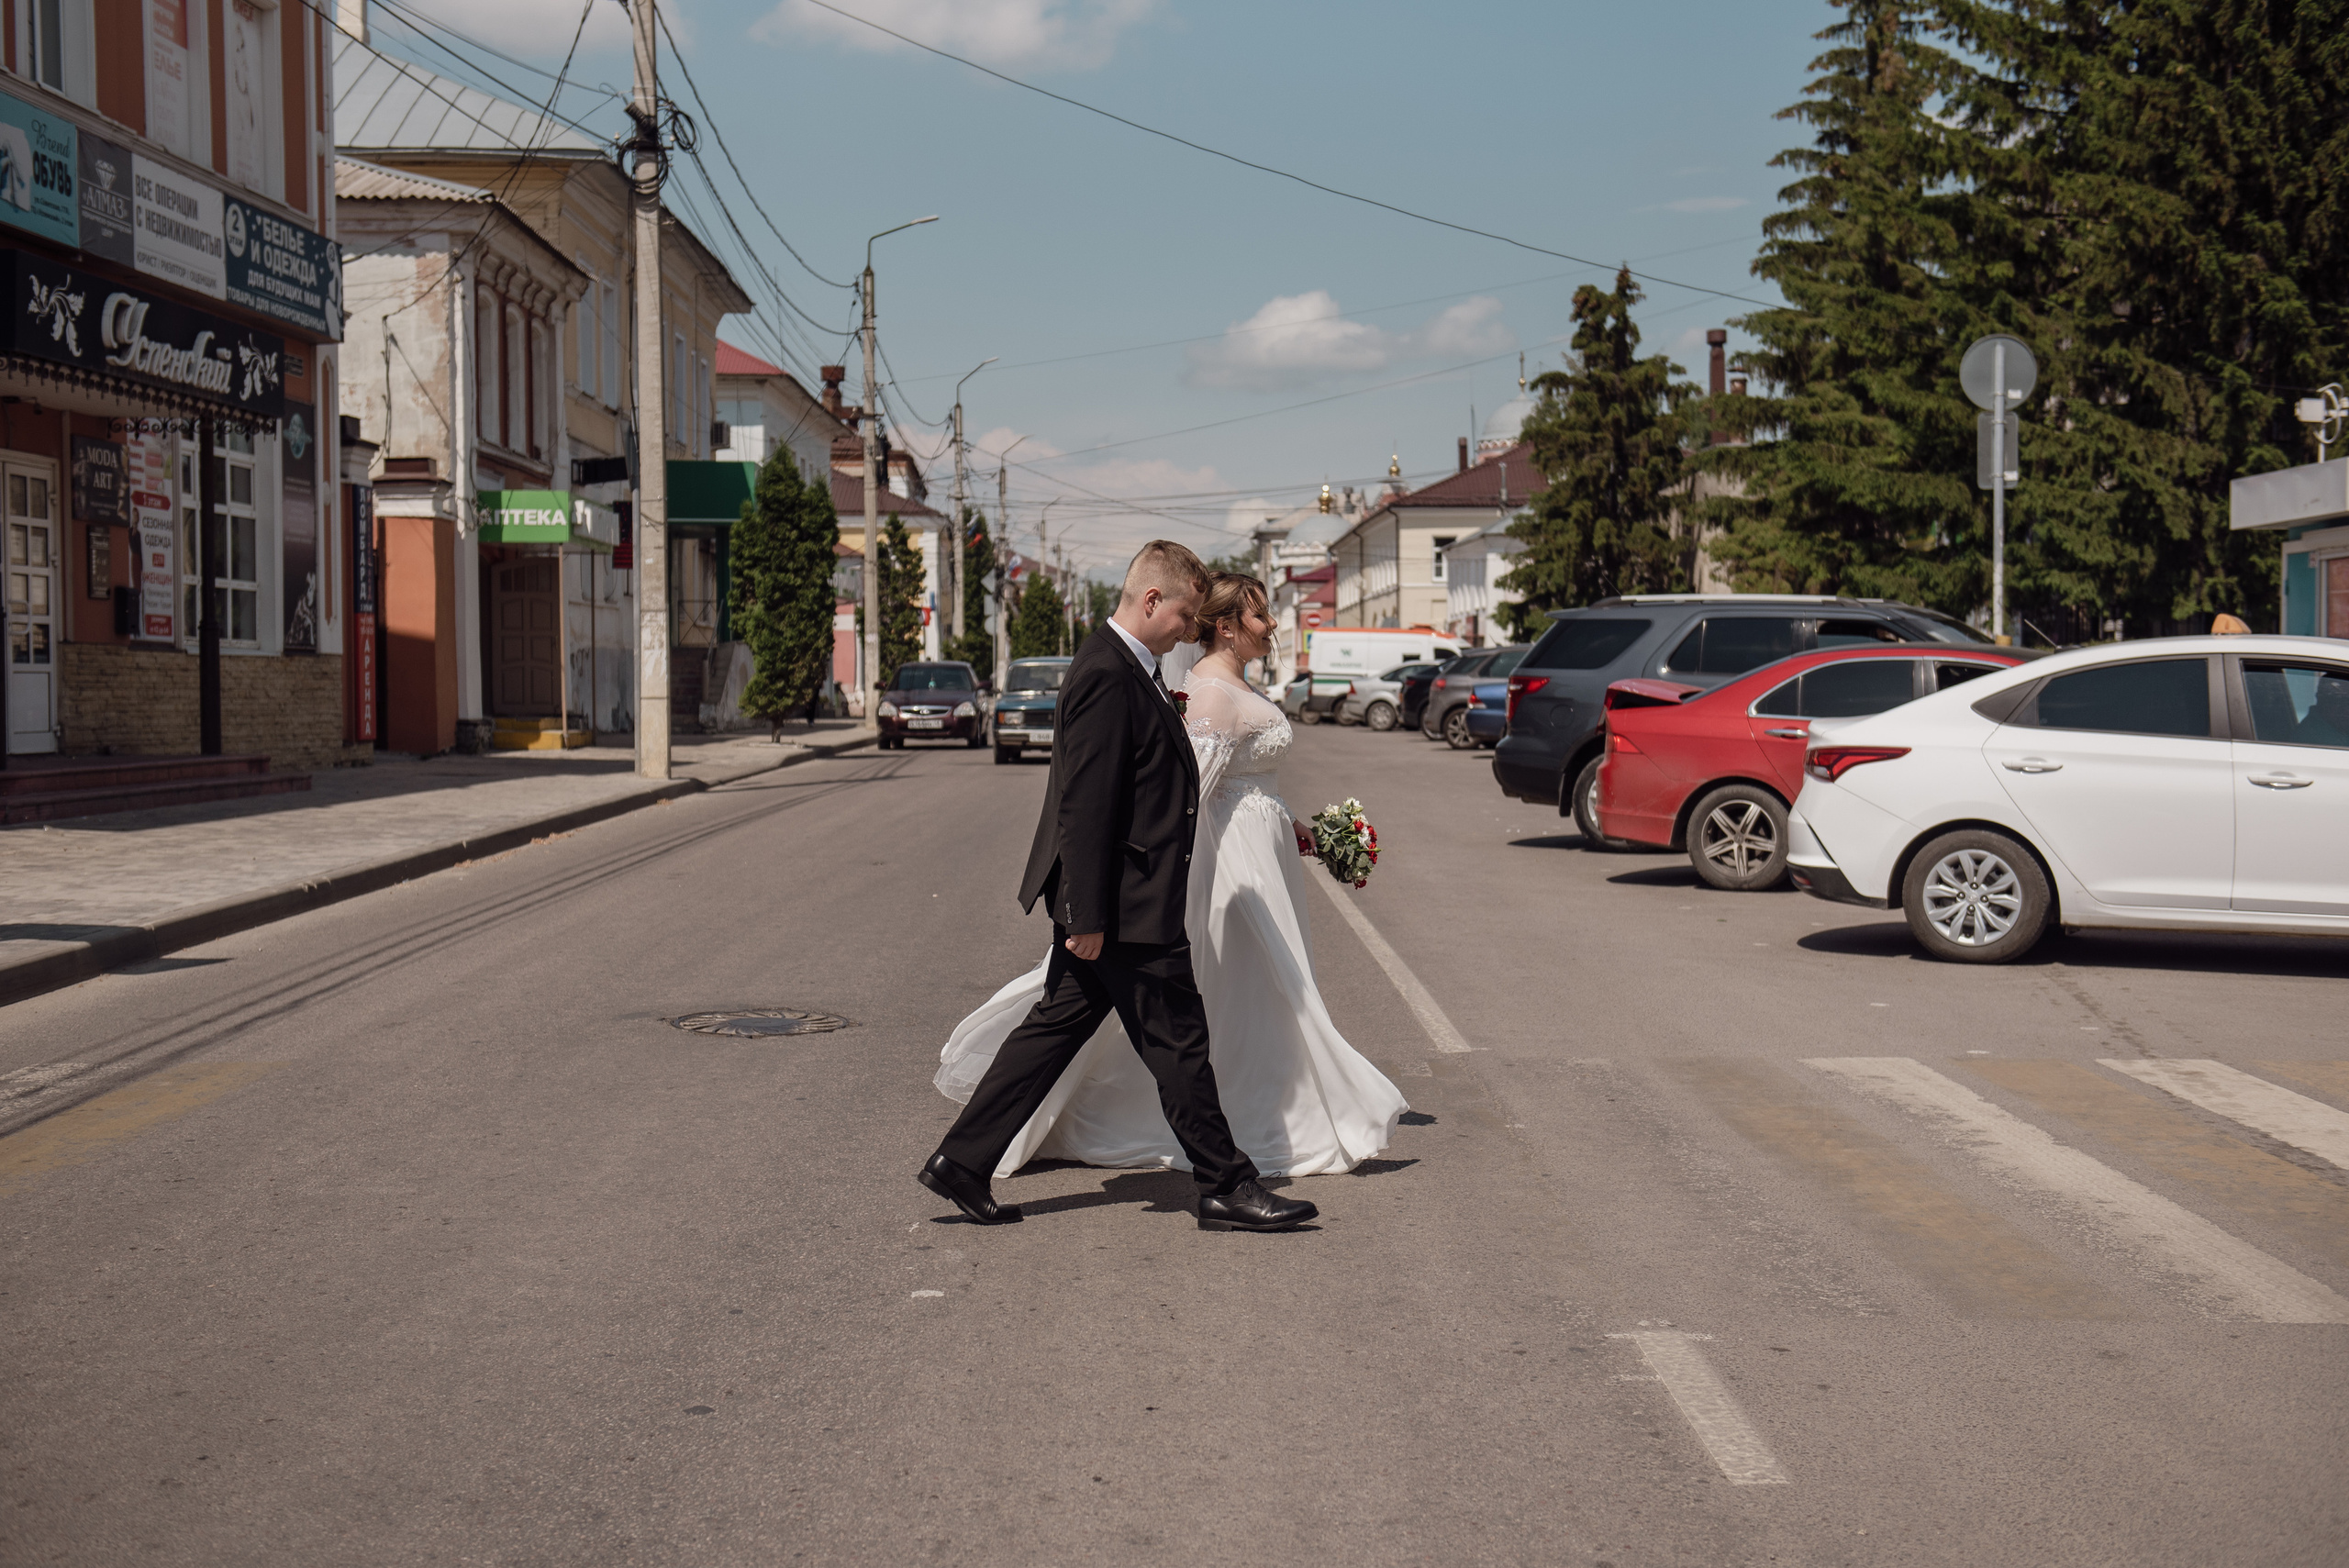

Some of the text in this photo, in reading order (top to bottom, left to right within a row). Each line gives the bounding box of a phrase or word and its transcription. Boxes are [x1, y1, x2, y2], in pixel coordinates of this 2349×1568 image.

[31, 119, 71, 158] Brend
[32, 150, 72, 197] ОБУВЬ
[135, 174, 199, 221] ВСЕ ОПЕРАЦИИ
[136, 205, 142, 228] С
[145, 208, 222, 259] НЕДВИЖИМОСТЬЮ
[231, 209, 240, 232] 2
[262, 217, 305, 256] БЕЛЬЕ
[136, 250, 157, 267] ЮРИСТ
[250, 239, 317, 287] И ОДЕЖДА
[247, 269, 321, 309] ДЛЯ БУДУЩИХ МАМ
[227, 286, 327, 332] ТОВАРЫ ДЛЯ НОВОРОЖДЕННЫХ
[101, 292, 232, 395] Успенский
[86, 445, 118, 469] MODA
[93, 471, 113, 491] ART
[480, 508, 567, 526] АПТЕКА
[145, 534, 172, 549] ОДЕЖДА
[363, 638, 372, 735] АРЕНДА
